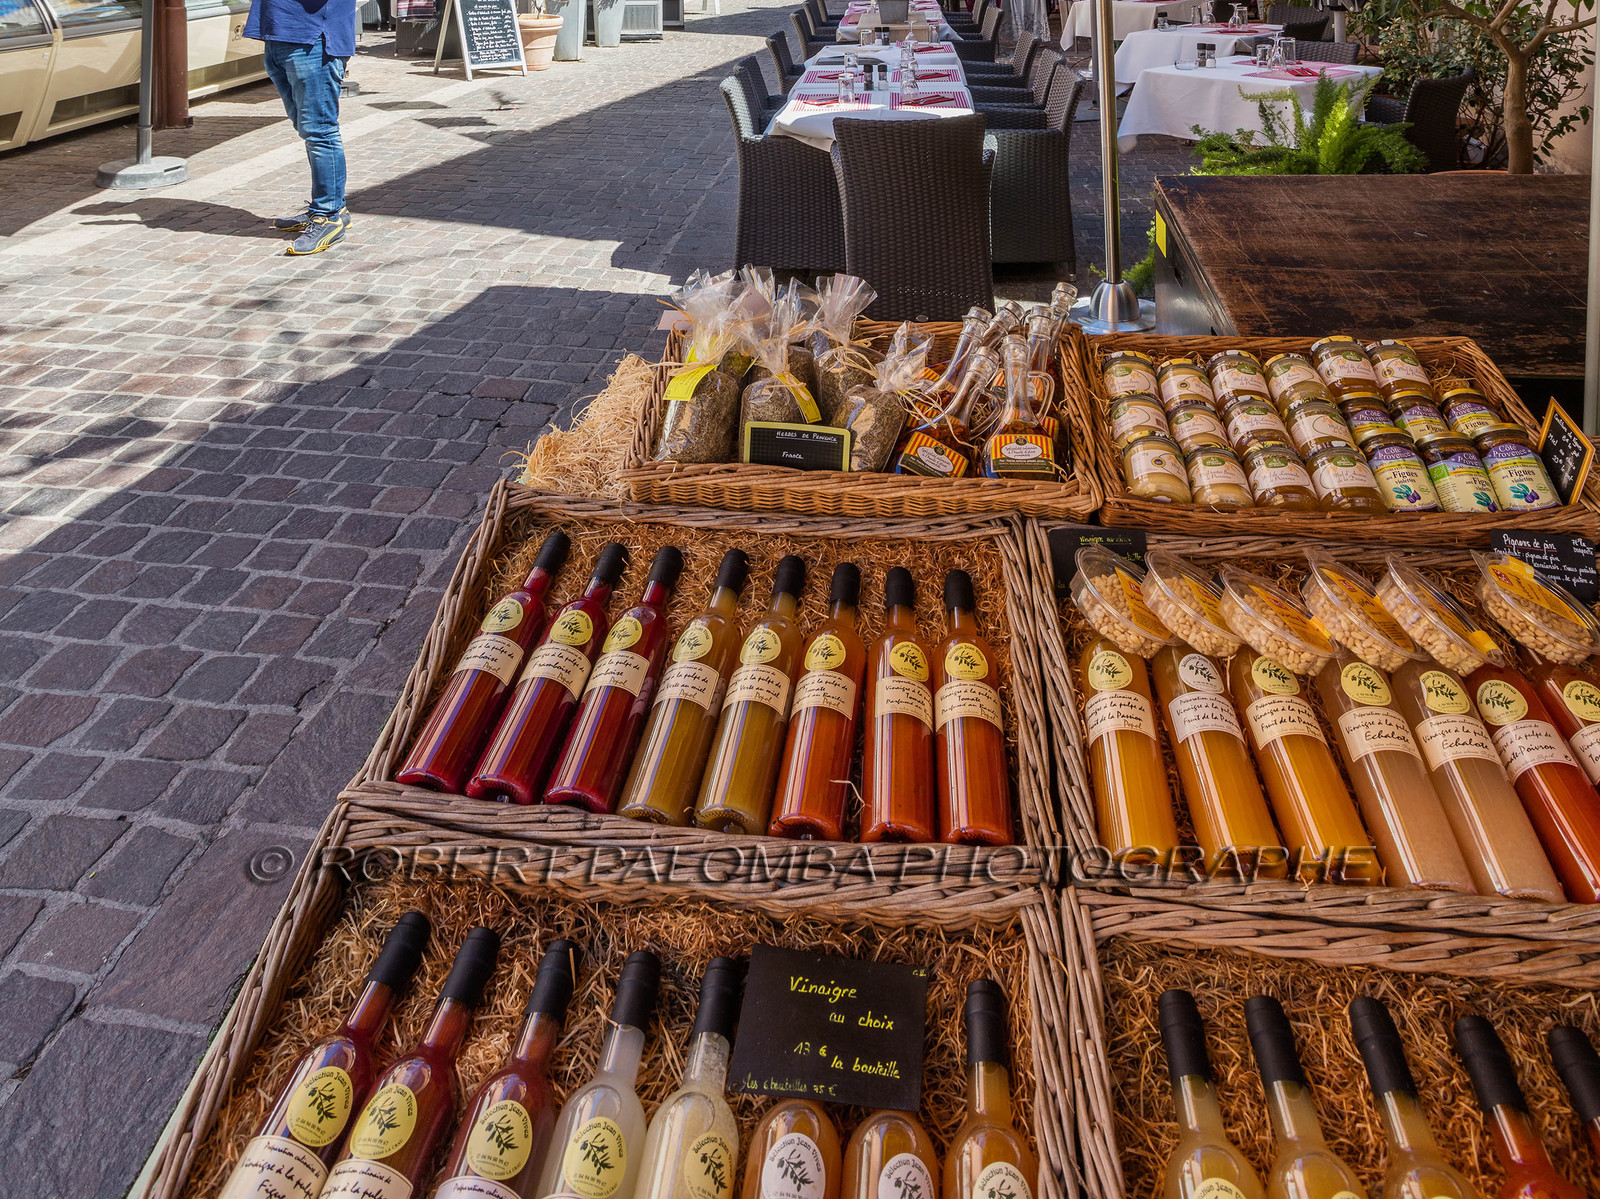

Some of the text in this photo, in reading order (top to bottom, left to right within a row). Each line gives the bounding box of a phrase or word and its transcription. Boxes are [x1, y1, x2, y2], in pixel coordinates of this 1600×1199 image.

[1455, 403, 1471, 411] Côté
[1464, 421, 1489, 430] Figues
[812, 433, 837, 442] PROVENCE
[1492, 449, 1526, 457] Provence
[1498, 444, 1516, 452] Côté
[782, 451, 803, 459] France
[1378, 452, 1411, 460] Provence
[1392, 471, 1418, 479] Figues
[1508, 470, 1535, 478] Figues
[1080, 535, 1104, 543] Vinaigre
[1503, 534, 1556, 554] Pignons de pin
[565, 658, 579, 667] pulpe
[758, 676, 774, 685] pulpe
[691, 685, 706, 694] miel
[766, 689, 780, 699] miel
[978, 692, 992, 700] pulpe
[1176, 703, 1202, 716] Vinaigre
[1253, 708, 1279, 722] Vinaigre
[1116, 711, 1144, 722] Passion
[1183, 714, 1200, 725] Fruit
[1123, 719, 1142, 729] Popol
[1261, 719, 1278, 731] Fruit
[1345, 721, 1375, 734] Vinaigre
[1385, 719, 1394, 727] la
[1422, 728, 1452, 743] Vinaigre
[1525, 731, 1542, 740] pulpe
[790, 976, 857, 1003] Vinaigre
[829, 1011, 894, 1030] au choix
[794, 1042, 828, 1057] 13 €
[830, 1055, 900, 1079] la bouteille
[304, 1071, 334, 1088] Sélection
[334, 1071, 347, 1087] Jean
[828, 1083, 838, 1096] €
[393, 1085, 413, 1116] Jean Vives
[480, 1103, 529, 1138] Sélection Jean Vives
[574, 1122, 601, 1144] Sélection
[602, 1121, 617, 1136] Jean
[692, 1135, 729, 1154] Sélection Jean
[264, 1141, 316, 1173] Préparation culinaire
[769, 1137, 821, 1172] Sélection Jean Vives
[359, 1167, 385, 1180] culinaire
[884, 1158, 926, 1180] Sélection Jean
[241, 1158, 313, 1199] Vinaigre à la pulpe
[978, 1166, 1020, 1191] Sélection Jean
[350, 1181, 360, 1194] la
[1215, 1182, 1233, 1195] Jean
